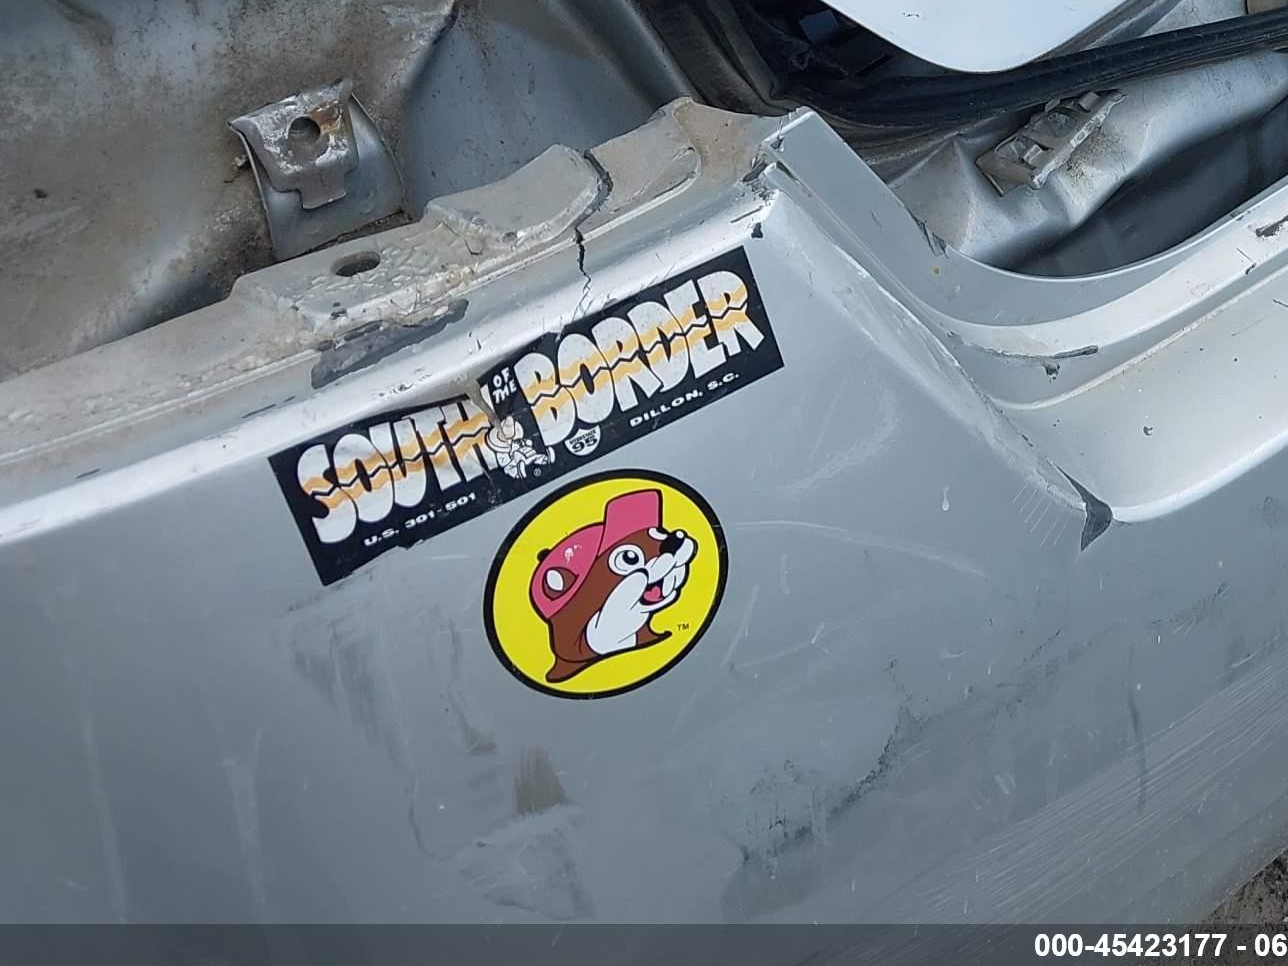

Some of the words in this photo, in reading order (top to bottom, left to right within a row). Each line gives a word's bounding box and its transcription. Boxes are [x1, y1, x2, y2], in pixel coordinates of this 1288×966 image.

[514, 270, 765, 447] BORDER
[492, 367, 510, 388] OF
[707, 372, 740, 390] S.C.
[492, 379, 518, 404] THE
[571, 435, 598, 453] 95
[297, 385, 498, 544] SOUTH
[364, 528, 399, 546] U.S.
